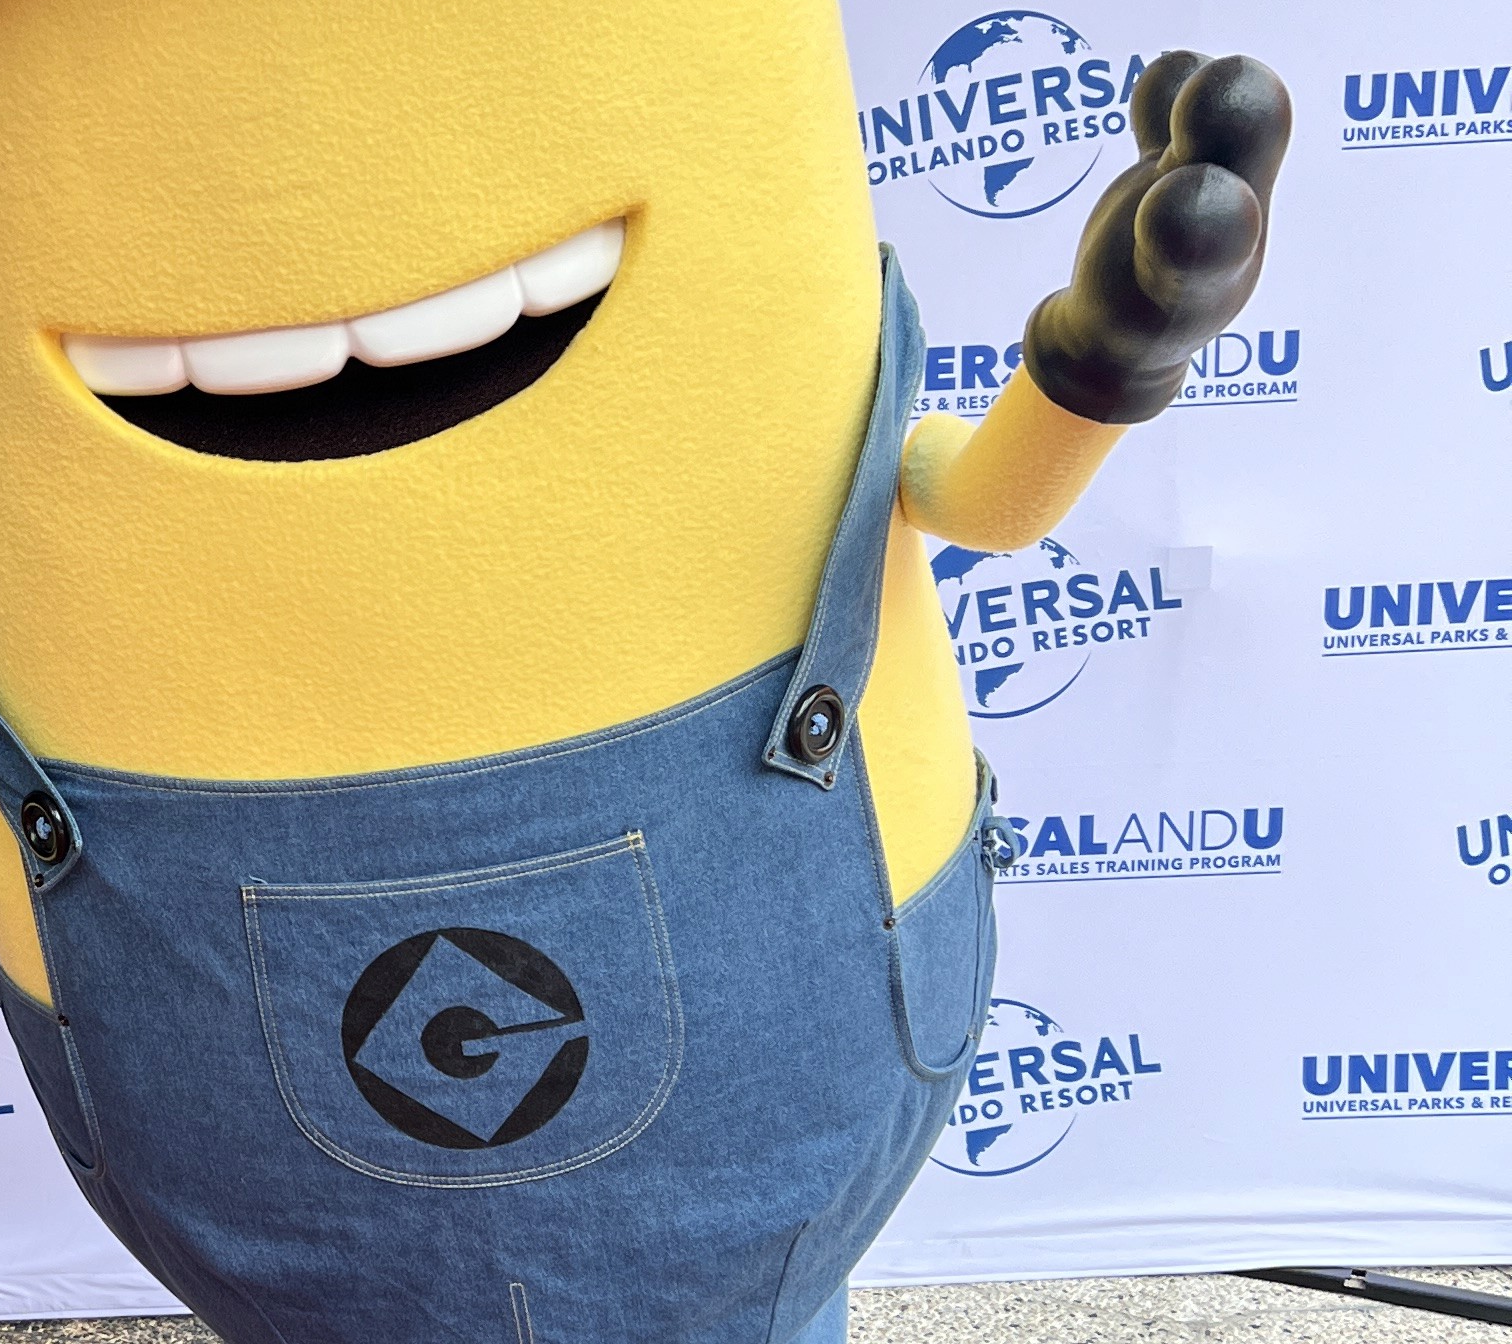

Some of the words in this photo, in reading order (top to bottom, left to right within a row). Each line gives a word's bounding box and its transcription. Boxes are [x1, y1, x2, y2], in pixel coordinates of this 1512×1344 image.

[858, 54, 1146, 154] NIVERSA
[1343, 123, 1449, 141] UNIVERSAL
[867, 129, 1025, 185] ORLANDO
[1204, 381, 1297, 398] PROGRAM
[1033, 616, 1151, 652] RESORT
[1324, 632, 1425, 650] UNIVERSAL
[1431, 628, 1488, 644] PARKS
[1495, 627, 1509, 641] &
[1036, 861, 1089, 875] SALES
[1096, 858, 1183, 873] TRAINING
[1189, 854, 1281, 870] PROGRAM
[1020, 1081, 1133, 1114] RESORT
[1303, 1099, 1402, 1113] UNIVERSAL
[1408, 1097, 1465, 1111] PARKS
[1471, 1096, 1484, 1109] &
